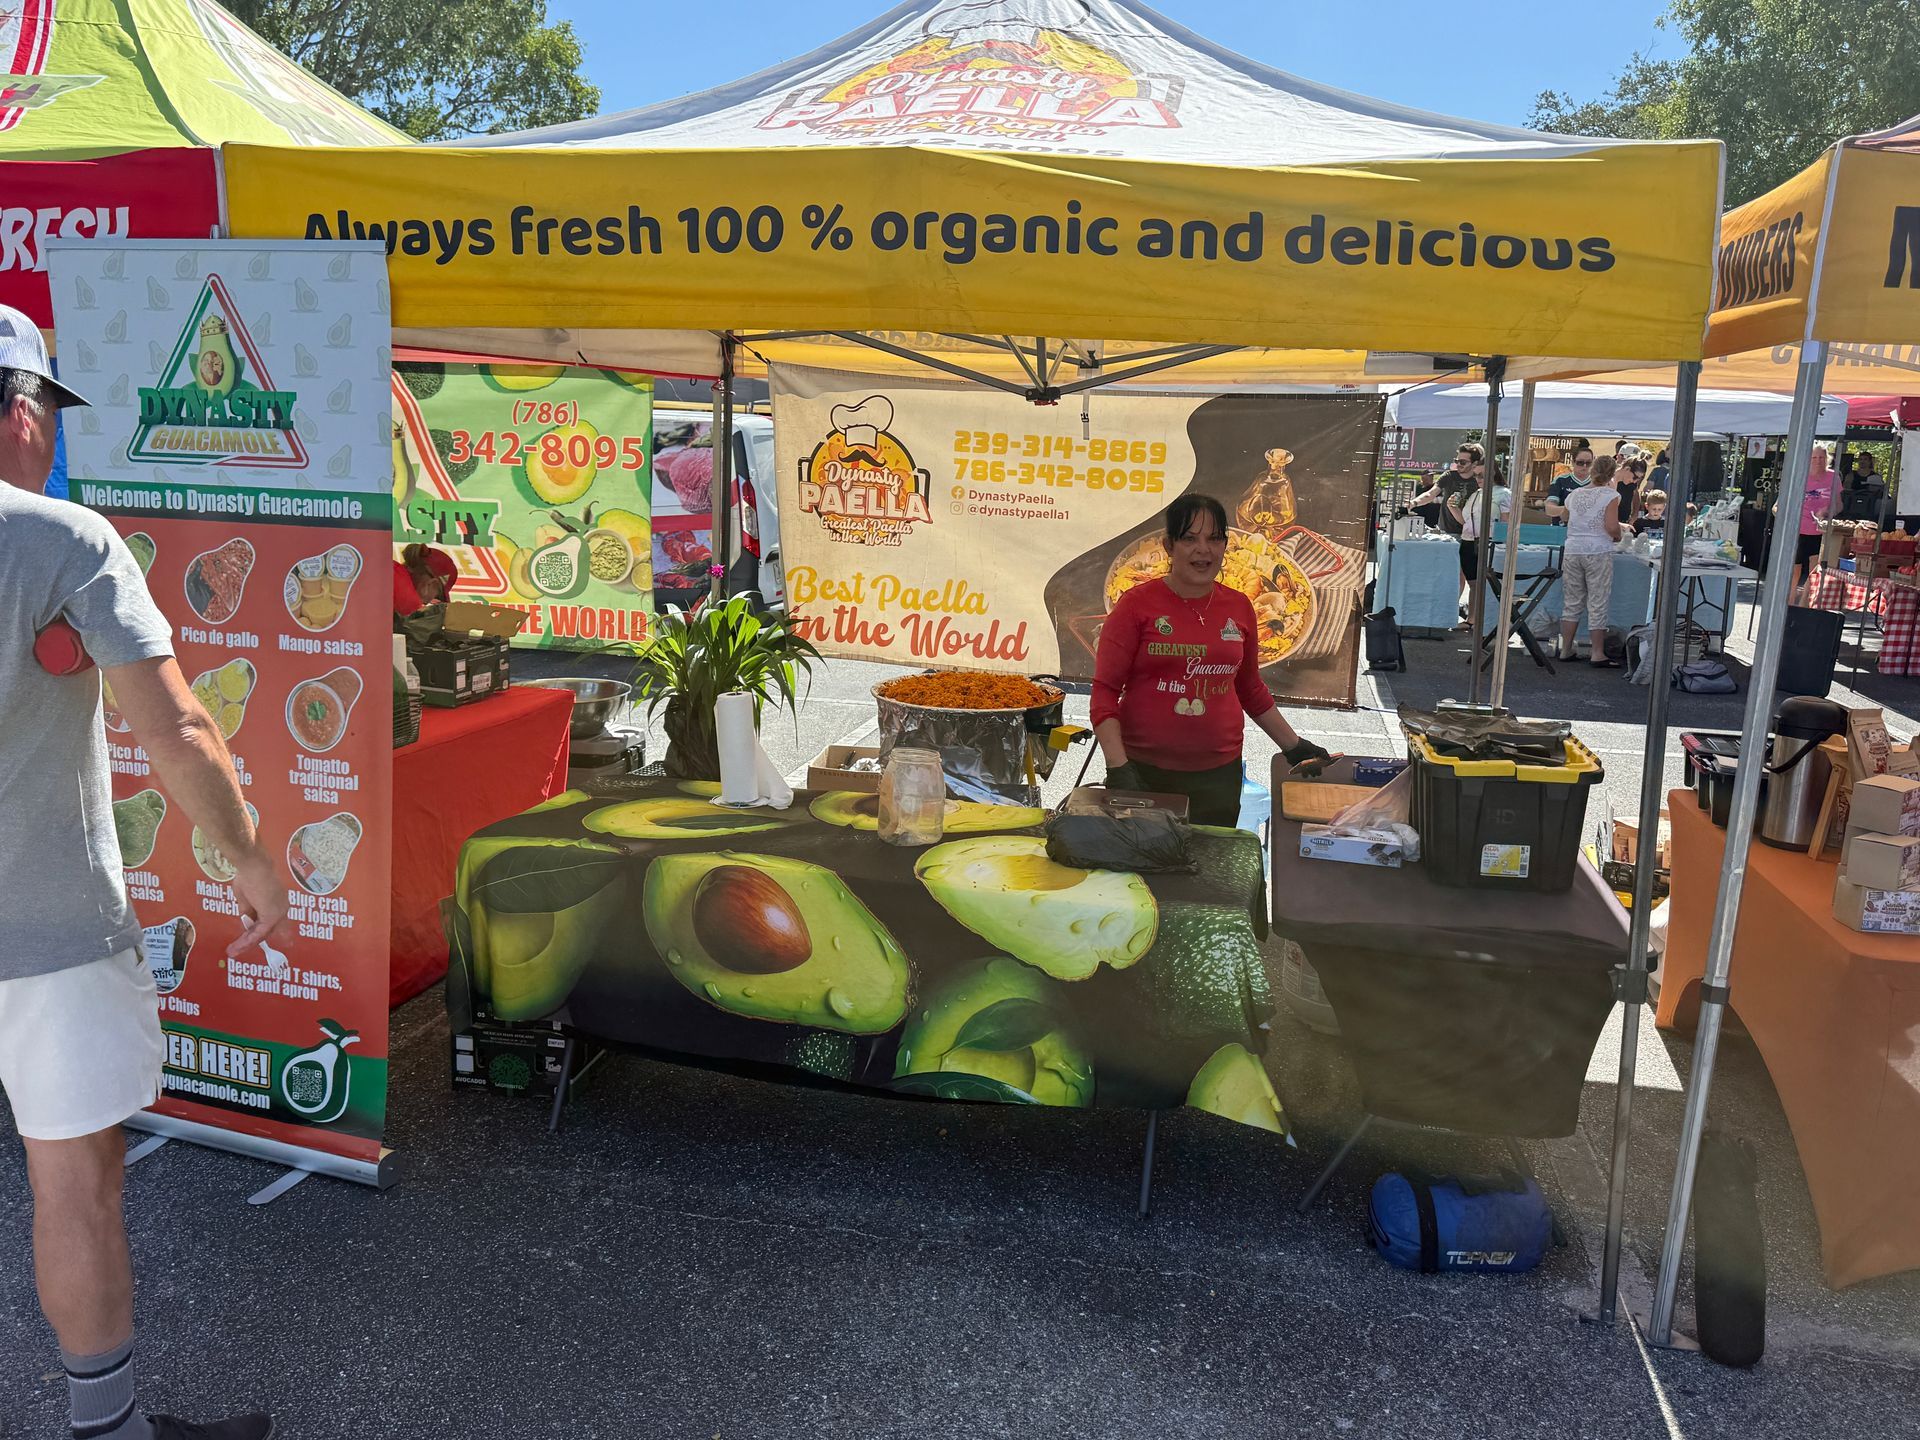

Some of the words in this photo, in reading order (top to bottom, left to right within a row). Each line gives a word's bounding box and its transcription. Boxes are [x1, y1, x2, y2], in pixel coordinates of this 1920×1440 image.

[866, 66, 1098, 99] Dynasty
[754, 86, 1182, 130] PAELLA
[304, 210, 496, 265] Always
[510, 205, 663, 256] fresh
[677, 205, 784, 254] 100
[801, 203, 854, 252] %
[870, 199, 1119, 265] organic
[1136, 210, 1264, 263] and
[1284, 213, 1616, 273] delicious
[137, 387, 297, 430] DYNASTY
[512, 399, 580, 428] (786)
[150, 427, 286, 455] GUACAMOLE
[449, 430, 645, 470] 342-8095
[954, 430, 1167, 465] 239-314-8869
[1528, 437, 1572, 450] EUROPEAN
[823, 461, 902, 496] Dynasty
[954, 457, 1165, 493] 786-342-8095
[81, 484, 162, 509] Welcome
[166, 488, 183, 510] to
[187, 489, 255, 517] Dynasty
[259, 494, 363, 520] Guacamole
[798, 481, 933, 524] PAELLA
[968, 489, 1054, 505] DynastyPaella
[967, 503, 1069, 520] @dynastypaella1
[820, 516, 869, 531] Greatest
[870, 519, 914, 535] Paella
[862, 531, 902, 547] World
[786, 565, 866, 605] Best
[870, 573, 990, 616] Paella
[548, 605, 648, 643] WORLD
[832, 604, 895, 648] the
[900, 612, 1029, 662] World
[181, 626, 206, 644] Pico
[209, 628, 224, 645] de
[225, 630, 259, 650] gallo
[279, 634, 321, 655] Mango
[324, 638, 363, 657] salsa
[1147, 642, 1207, 657] GREATEST
[1157, 678, 1166, 692] in
[1168, 680, 1186, 694] the
[296, 754, 350, 775] Tomatto
[288, 769, 359, 791] traditional
[304, 788, 339, 805] salsa
[130, 886, 164, 902] salsa
[288, 889, 316, 908] Blue
[318, 897, 348, 913] crab
[202, 898, 240, 916] cevich
[308, 908, 355, 928] lobster
[299, 923, 334, 941] salad
[227, 972, 254, 990] hats
[256, 978, 280, 995] and
[282, 983, 318, 1001] apron
[292, 967, 300, 983] T
[302, 970, 343, 992] shirts,
[168, 996, 200, 1017] Chips
[201, 1041, 269, 1085] HERE!
